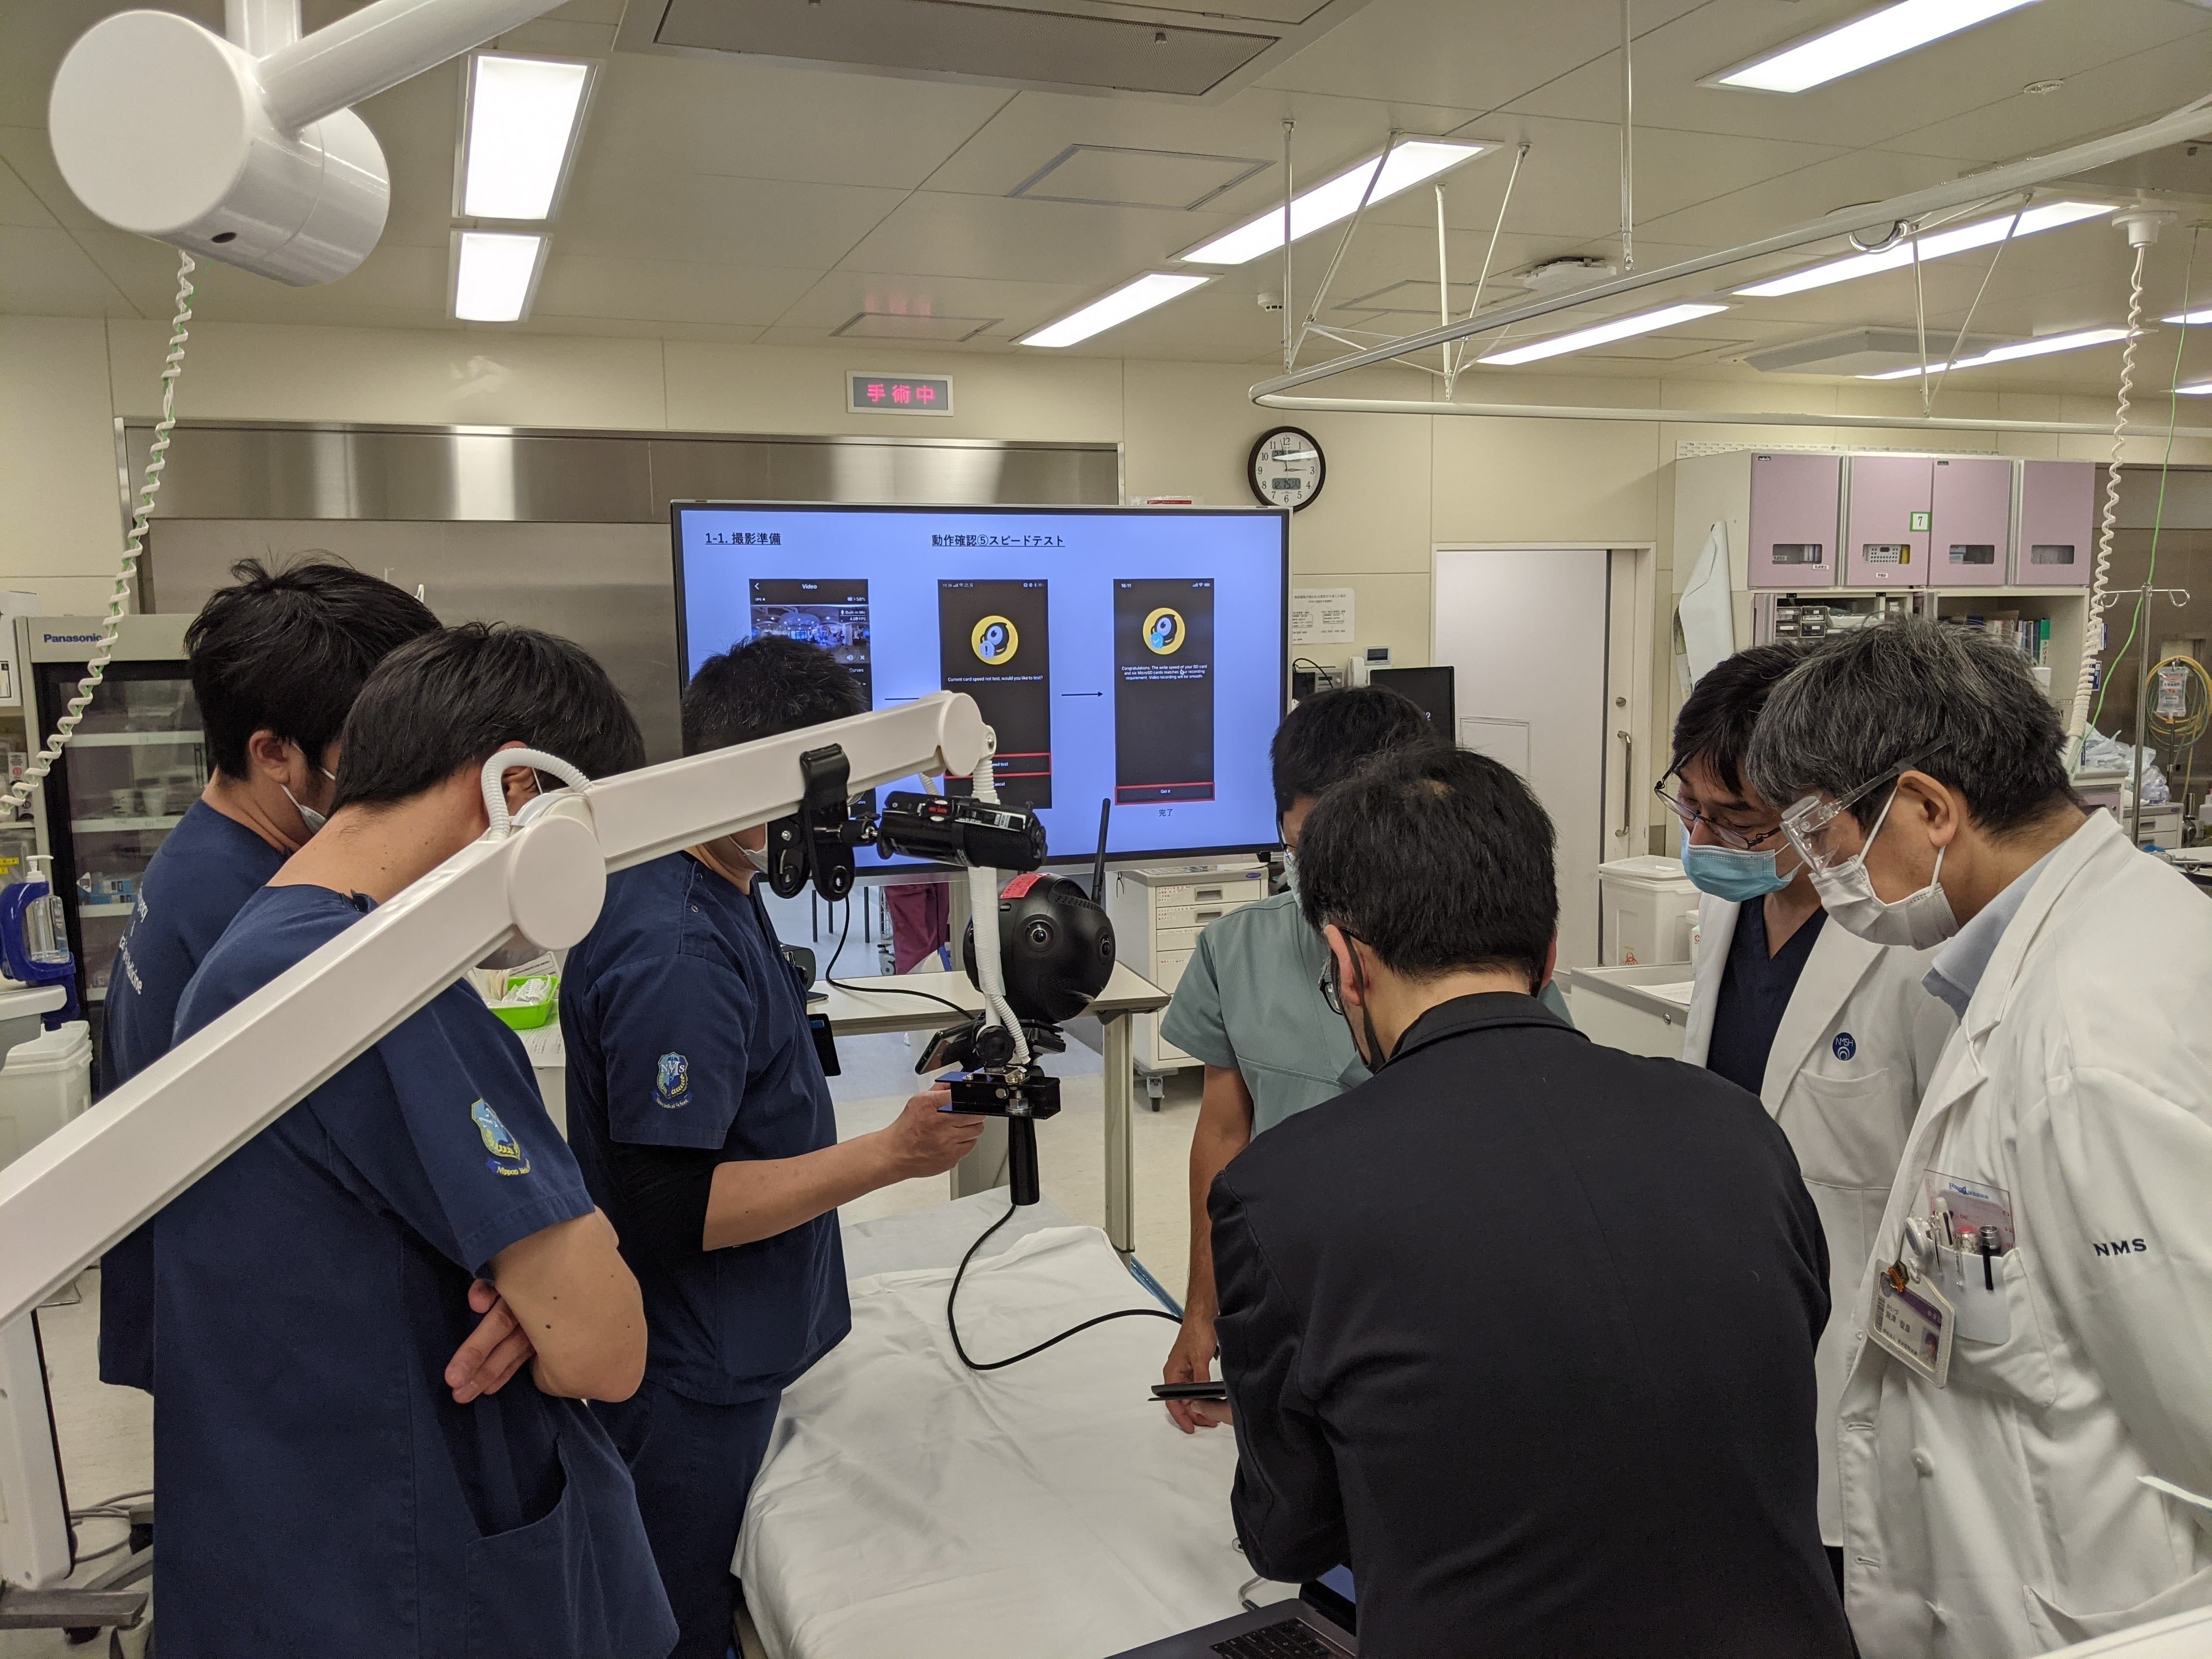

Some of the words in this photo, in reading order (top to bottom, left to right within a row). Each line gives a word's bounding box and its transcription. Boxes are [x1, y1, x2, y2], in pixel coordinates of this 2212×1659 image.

[867, 383, 935, 404] 手術中
[1262, 453, 1268, 461] 10
[1262, 481, 1267, 489] 8
[1306, 481, 1311, 489] 4
[1918, 516, 1923, 527] 7
[706, 533, 727, 543] 1-1.
[732, 532, 781, 545] 撮影準備
[932, 534, 1063, 546] 動作確認⑤スピードテスト
[44, 633, 103, 642] Panasonic
[1159, 809, 1173, 817] 完了
[661, 1060, 685, 1075] NMS
[2093, 1238, 2147, 1256] NMS
